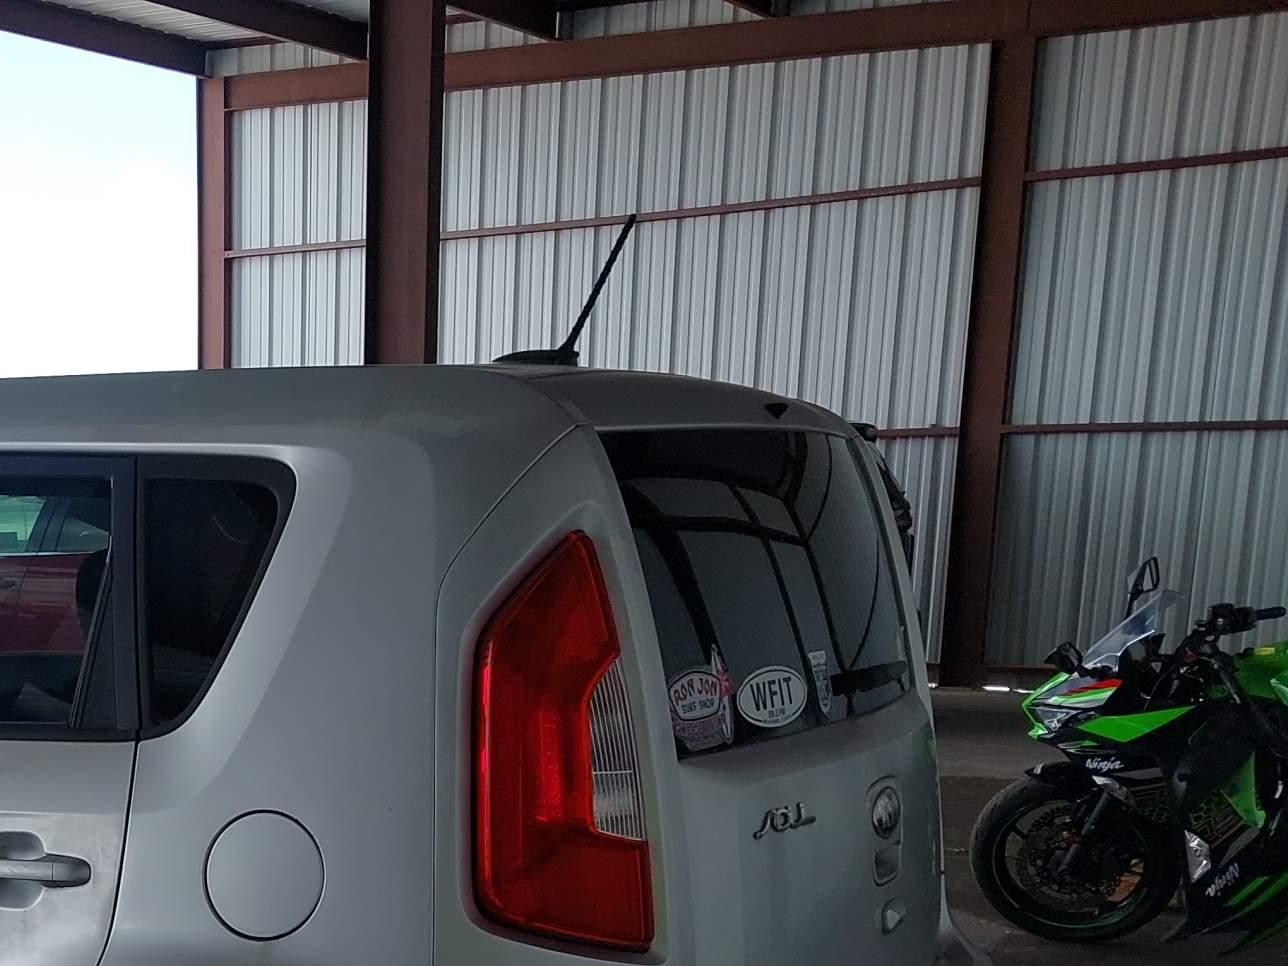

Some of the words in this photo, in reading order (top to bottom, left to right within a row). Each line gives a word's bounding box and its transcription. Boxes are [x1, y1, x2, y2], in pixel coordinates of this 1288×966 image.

[673, 678, 695, 706] RON
[697, 677, 718, 696] JON
[749, 676, 793, 712] WFIT
[1085, 756, 1125, 773] Ninja
[1204, 862, 1240, 897] Ninja
